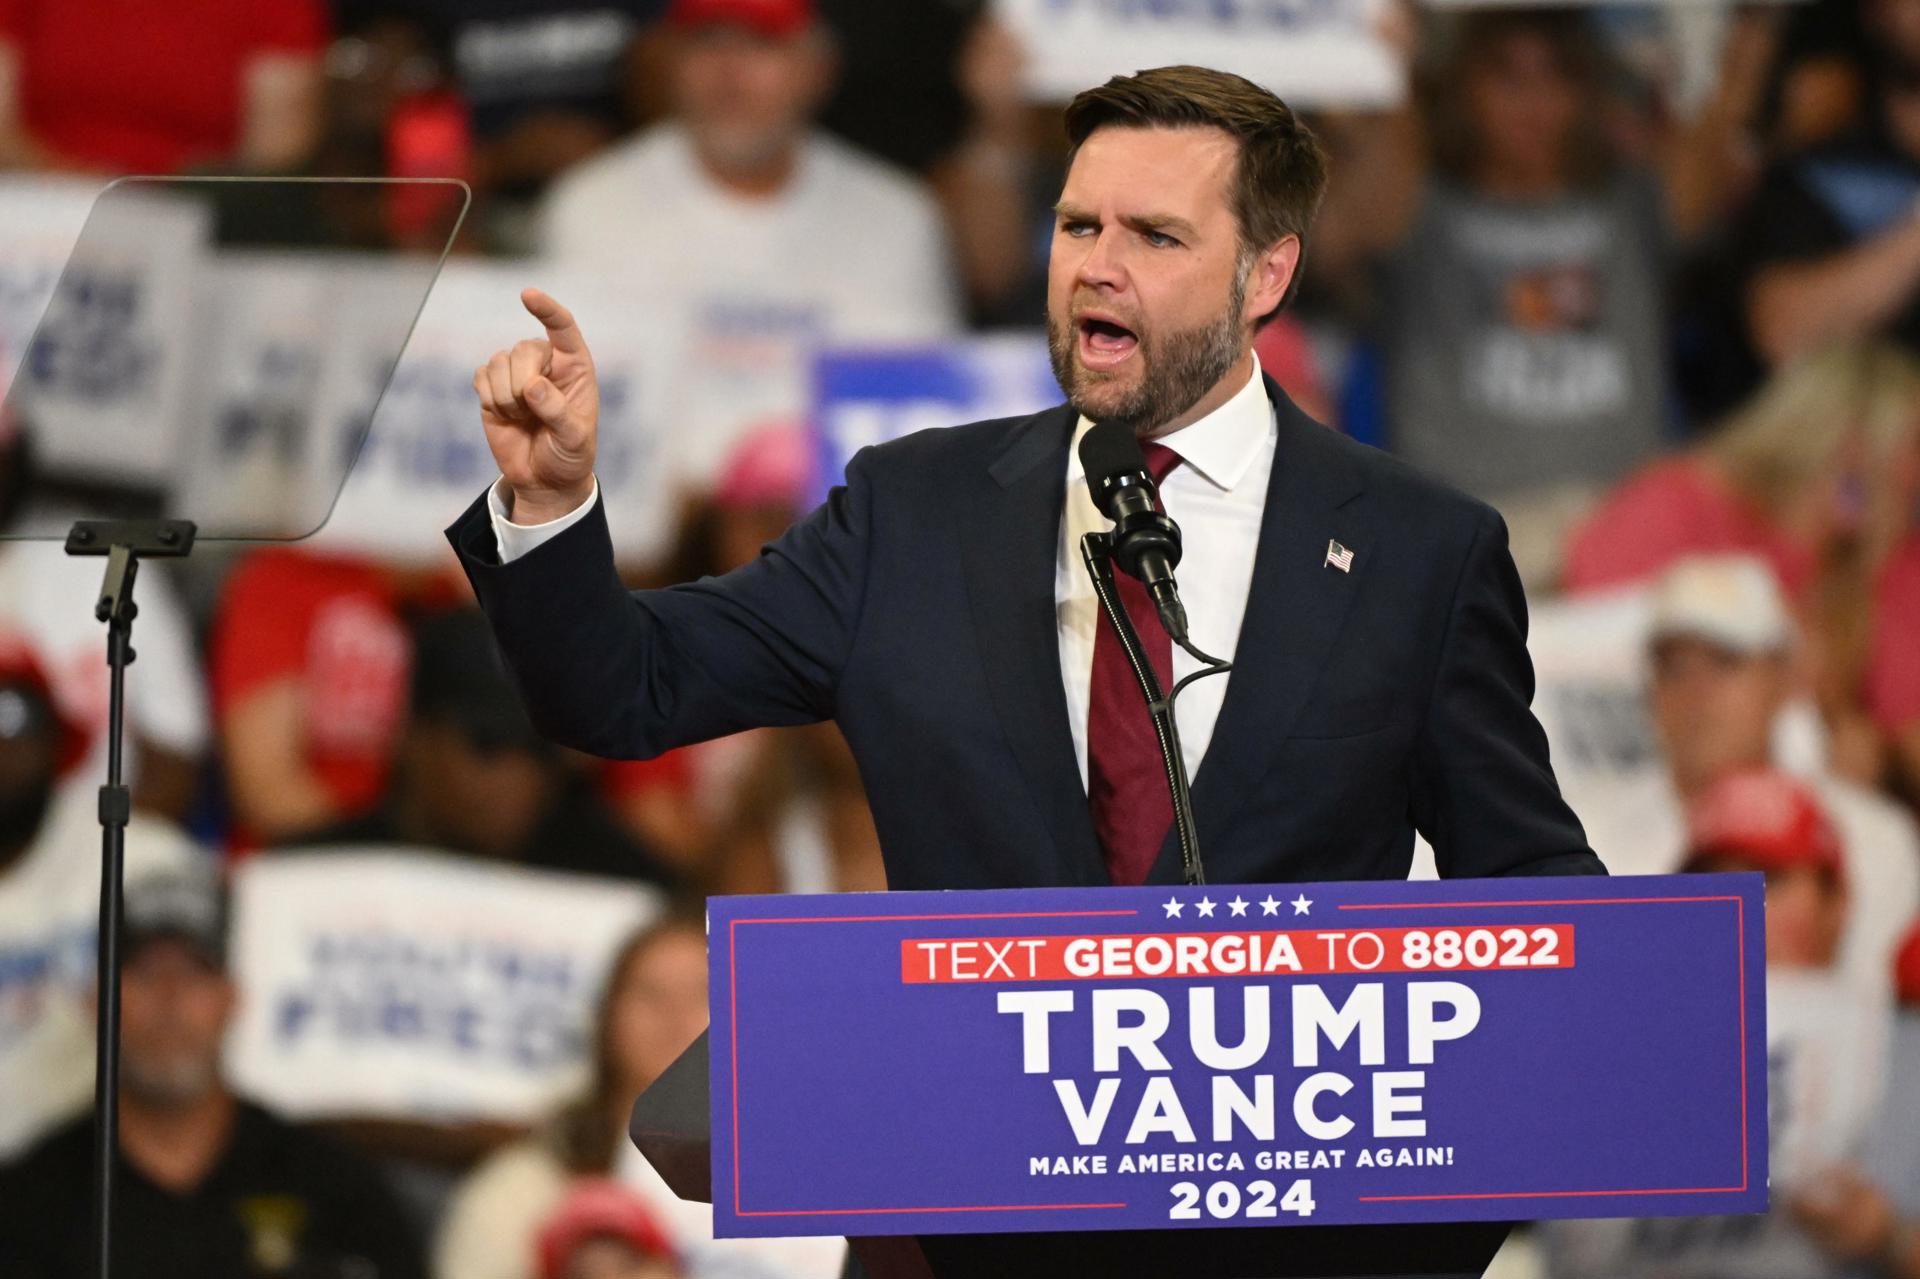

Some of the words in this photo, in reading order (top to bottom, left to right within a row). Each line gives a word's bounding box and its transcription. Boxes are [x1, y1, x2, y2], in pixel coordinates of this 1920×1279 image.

[917, 937, 1047, 980] TEXT
[1063, 934, 1303, 977] GEORGIA
[1316, 931, 1386, 971] TO
[1401, 927, 1560, 969] 88022
[996, 980, 1482, 1075] TRUMP
[1051, 1070, 1427, 1146] VANCE
[1029, 1154, 1108, 1177] MAKE
[1117, 1152, 1246, 1175] AMERICA
[1255, 1149, 1347, 1172] GREAT
[1355, 1146, 1455, 1169] AGAIN!
[1168, 1178, 1317, 1220] 2024
